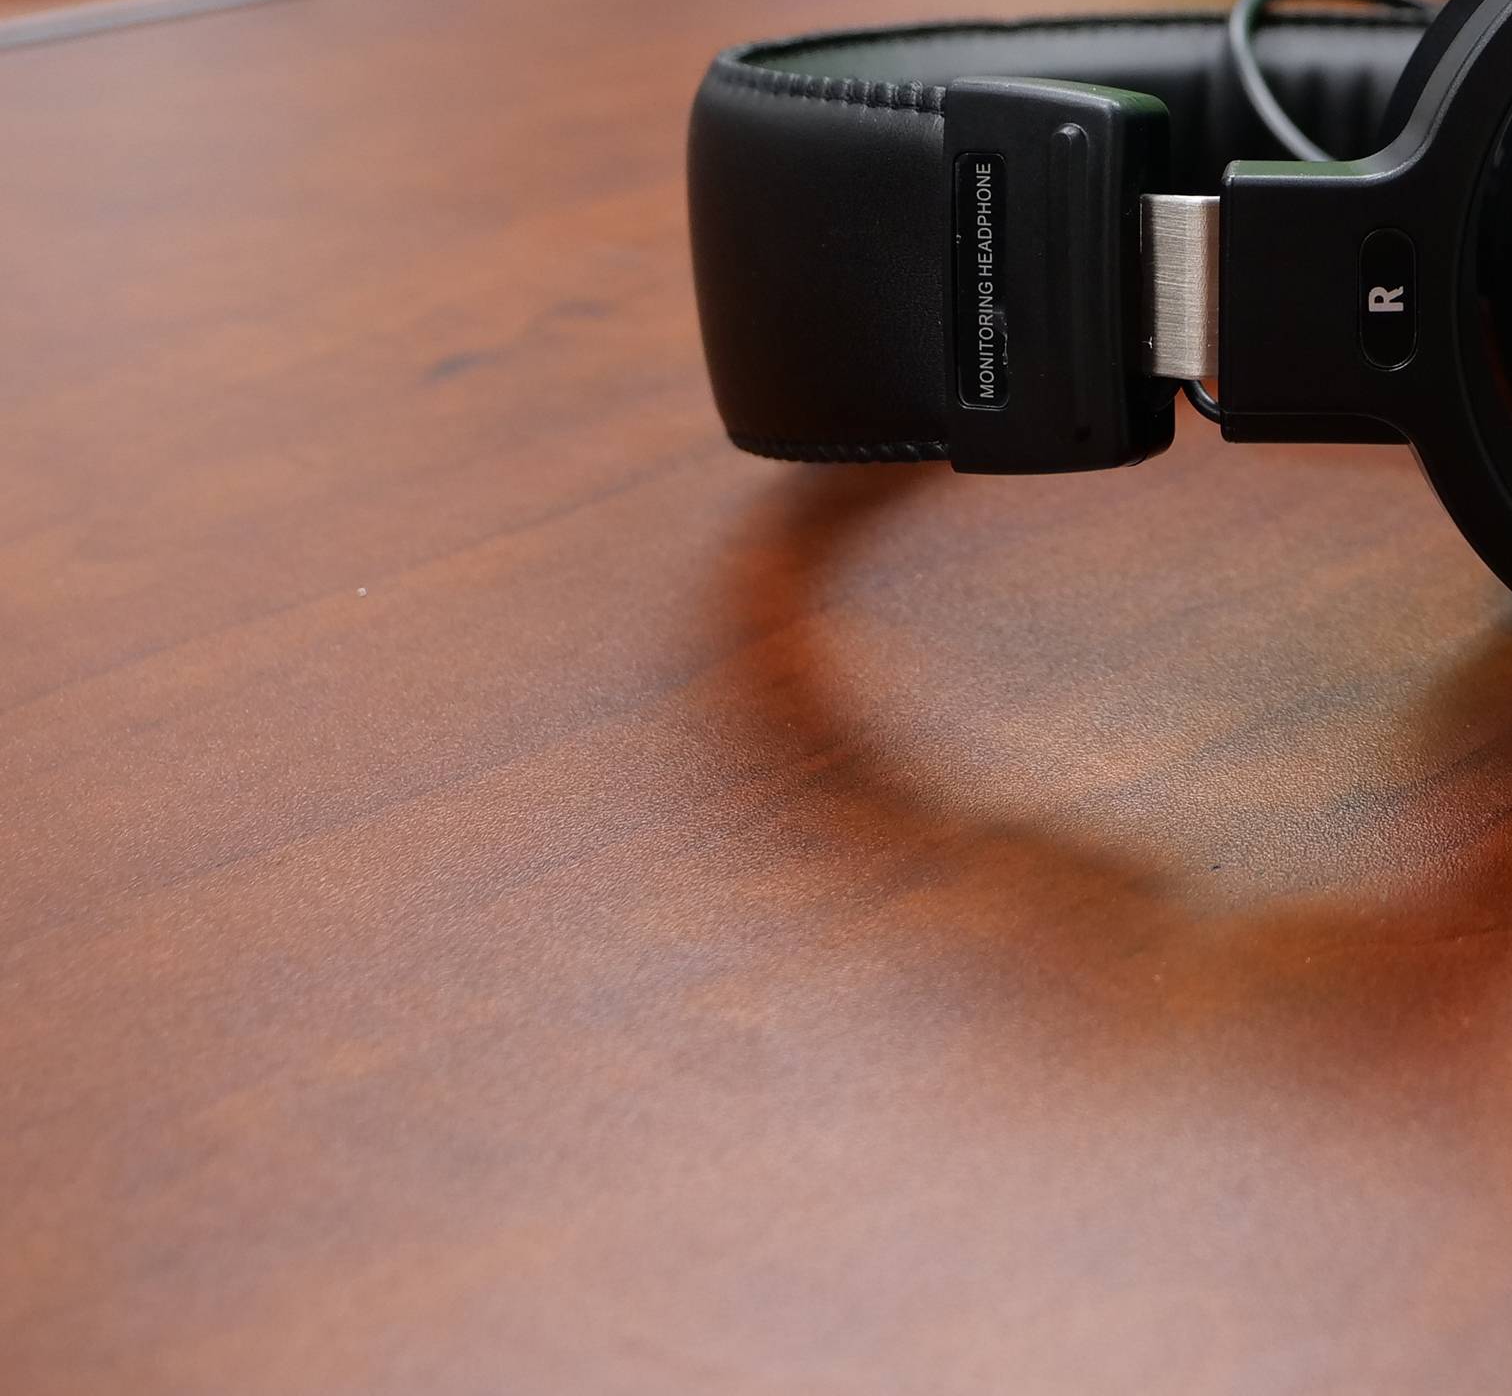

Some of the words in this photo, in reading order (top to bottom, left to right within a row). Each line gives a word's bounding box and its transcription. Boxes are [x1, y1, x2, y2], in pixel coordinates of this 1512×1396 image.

[975, 162, 993, 277] HEADPHONE
[977, 280, 995, 399] MONITORING
[1368, 286, 1404, 312] R
